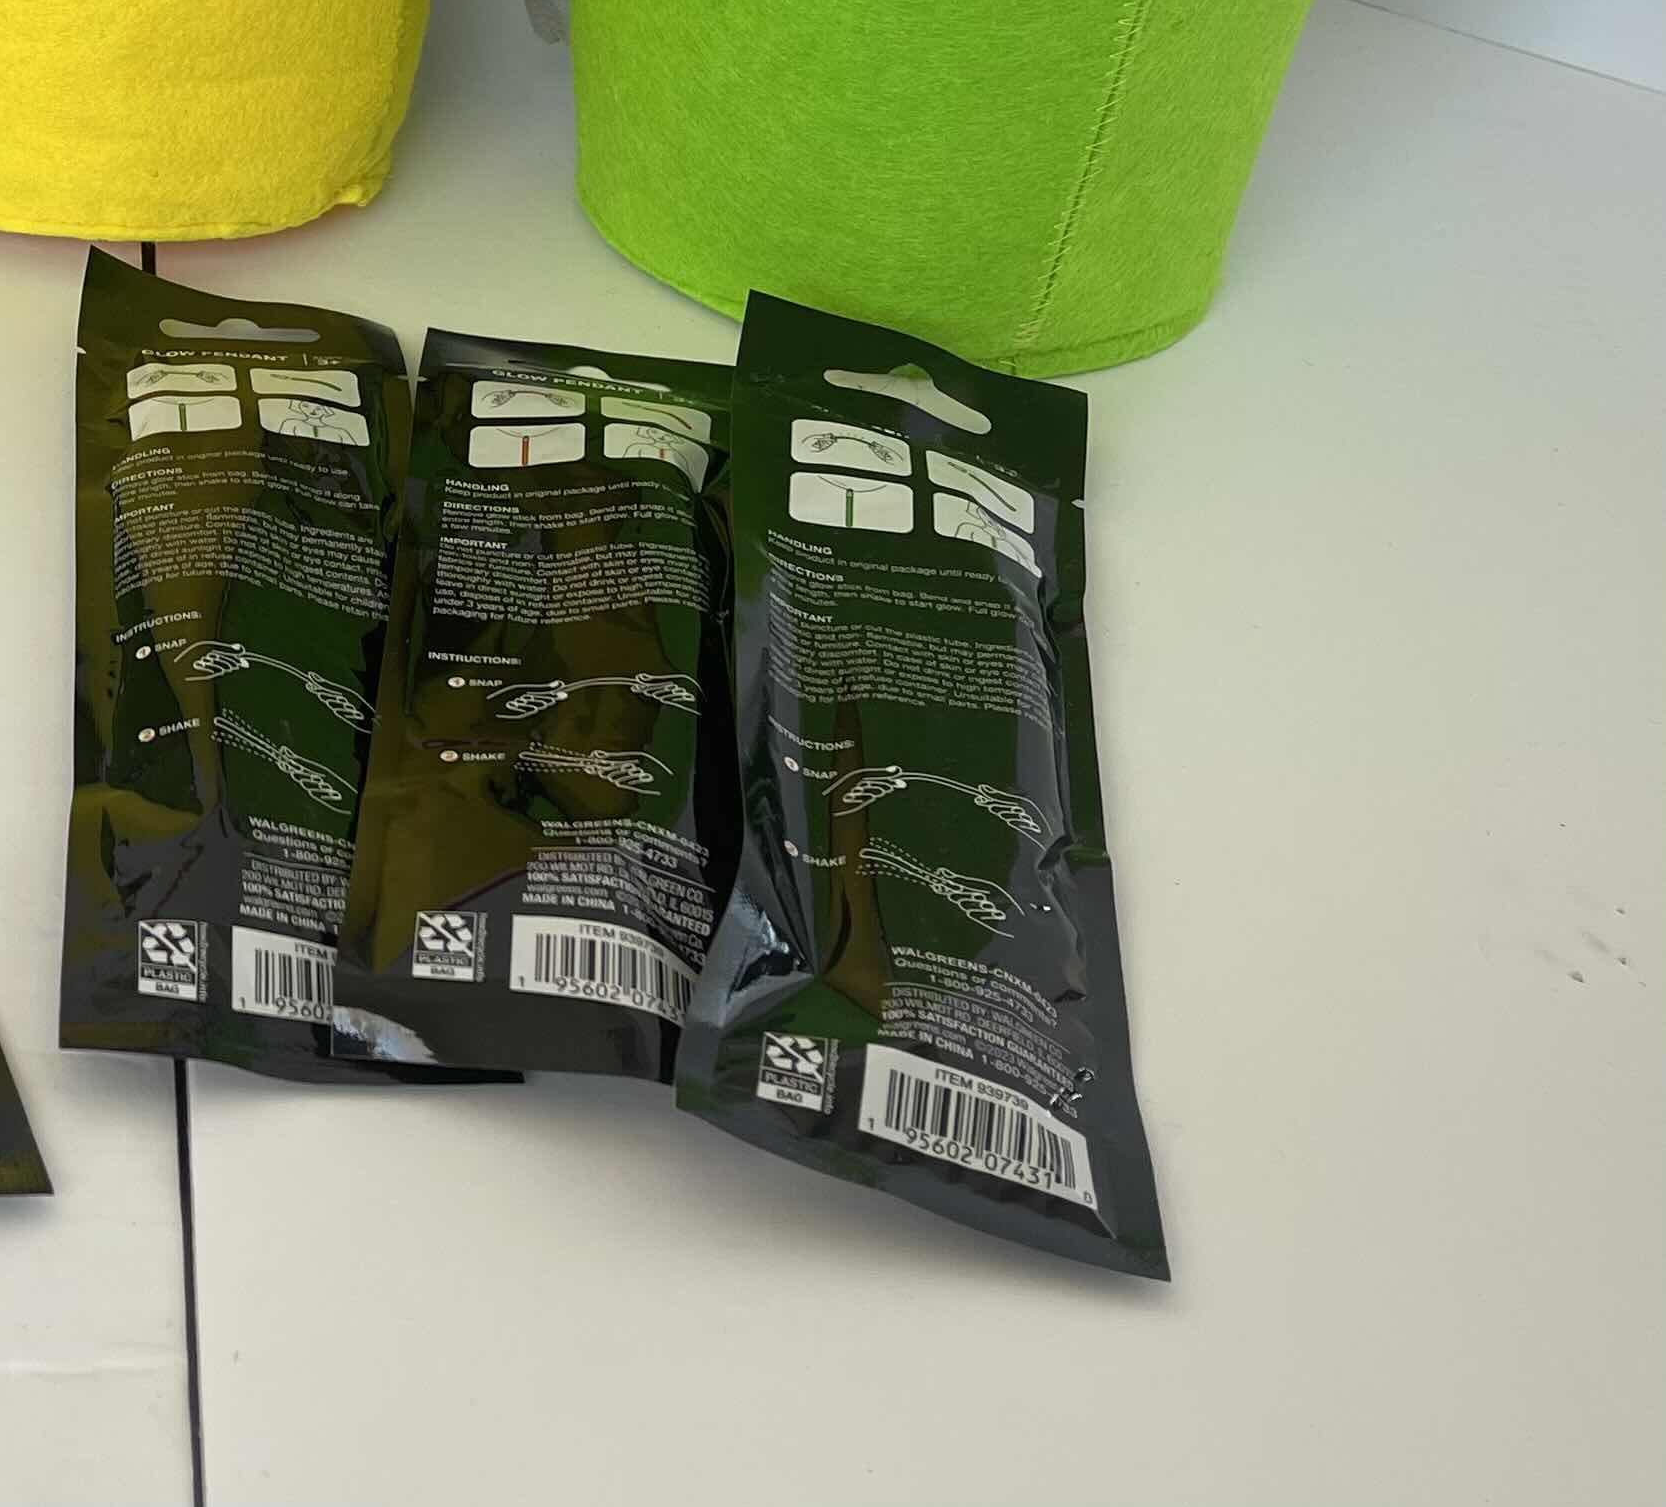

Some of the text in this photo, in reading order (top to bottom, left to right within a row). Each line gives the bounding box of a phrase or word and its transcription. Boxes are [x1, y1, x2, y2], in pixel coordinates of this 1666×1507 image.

[141, 348, 288, 362] GLOW PENDANT
[492, 369, 645, 396] GLOW PENDANT
[111, 467, 183, 490] DIRECTIONS
[445, 479, 510, 492] HANDLING
[443, 501, 520, 514] DIRECTIONS
[440, 537, 508, 549] IMPORTANT
[767, 529, 833, 555] HANDLING
[850, 560, 996, 583] original package until ready
[433, 606, 539, 625] packaging for future
[115, 611, 203, 643] INSTRUCTIONS:
[154, 638, 186, 652] SNAP
[428, 651, 522, 666] INSTRUCTIONS:
[469, 678, 503, 687] SNAP
[158, 718, 200, 736] SHAKE
[463, 752, 506, 762] SHAKE
[802, 768, 837, 780] SNAP
[252, 828, 333, 854] Questions or
[802, 855, 846, 867] SHAKE
[522, 893, 615, 911] MADE IN CHINA
[240, 904, 325, 933] MADE IN CHINA
[579, 924, 615, 938] ITEM
[294, 943, 328, 959] ITEM
[418, 955, 467, 966] PLASTIC
[144, 968, 192, 983] PLASTIC
[430, 967, 455, 976] BAG
[894, 958, 986, 984] Questions or
[155, 982, 179, 994] BAG
[554, 976, 621, 1001] 95602
[240, 996, 246, 1008] 1
[917, 1009, 1006, 1048] SATISFACTION
[920, 1030, 933, 1045] IN
[936, 1037, 974, 1060] CHINA
[765, 1072, 820, 1094] PLASTIC
[936, 1070, 973, 1091] ITEM
[776, 1090, 803, 1103] BAG
[867, 1117, 1053, 1189] 1 95602 07431
